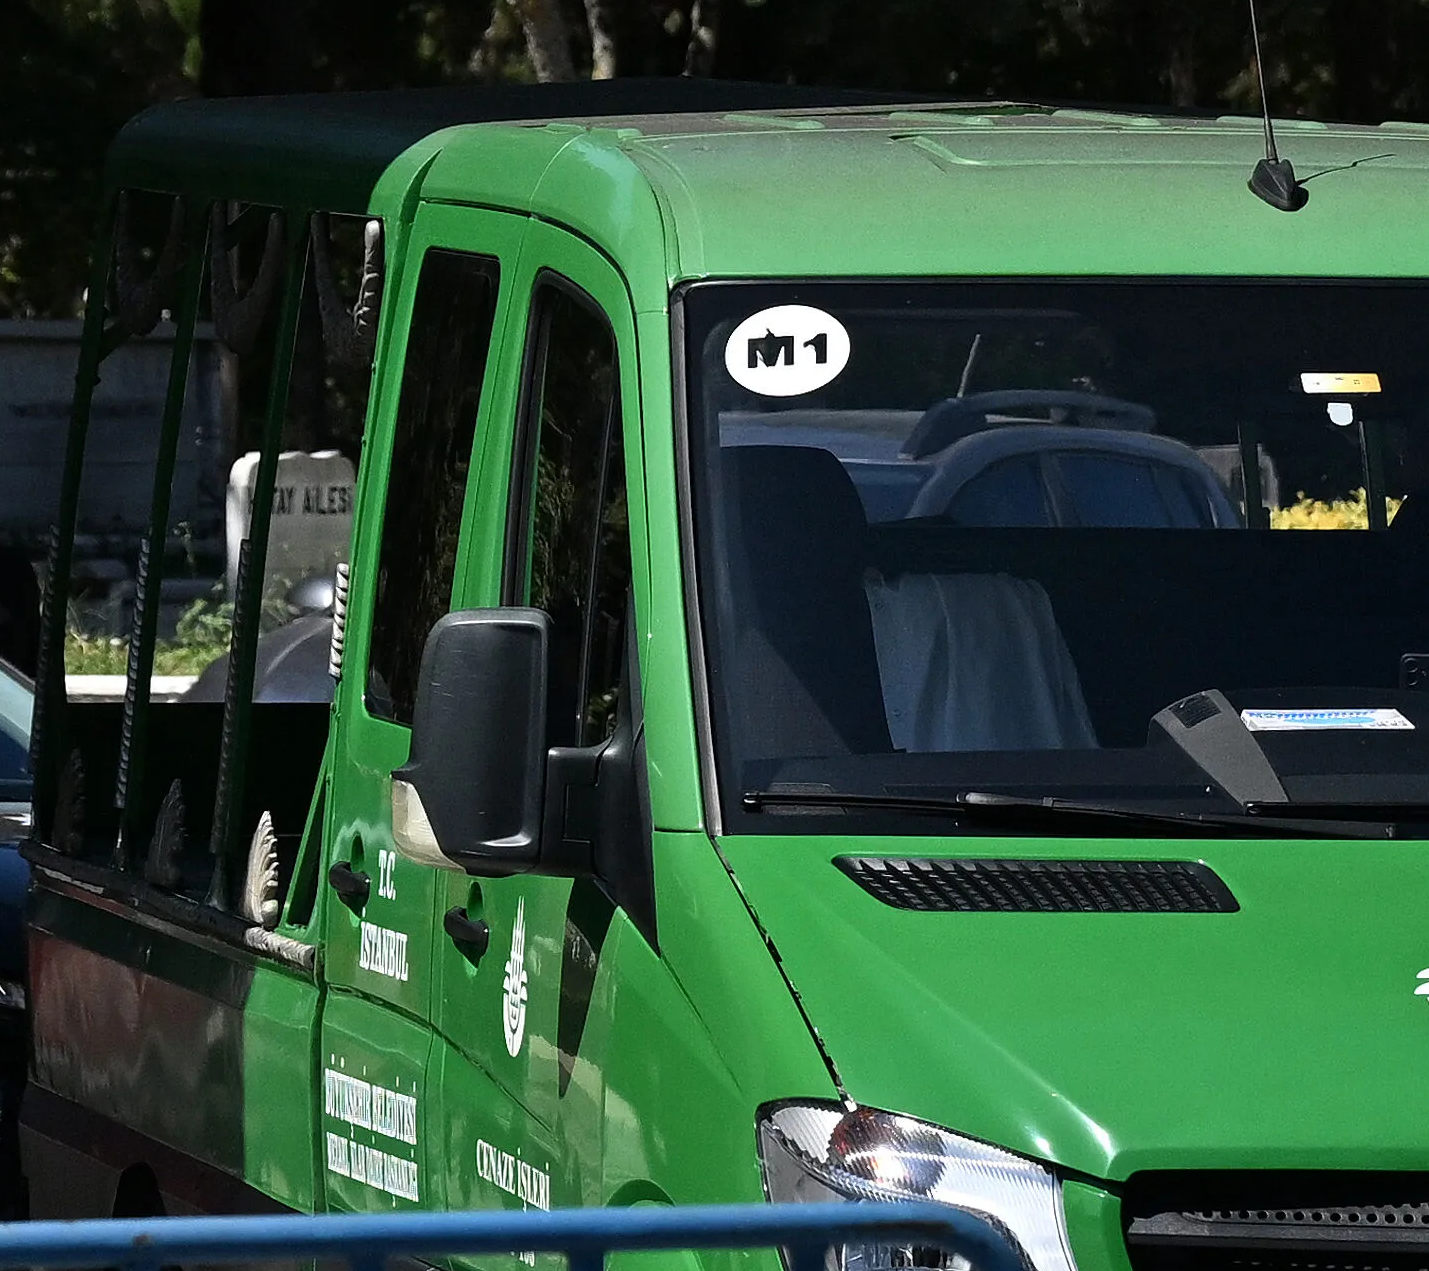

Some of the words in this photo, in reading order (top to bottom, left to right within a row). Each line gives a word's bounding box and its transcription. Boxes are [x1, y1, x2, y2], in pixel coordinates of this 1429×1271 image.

[378, 849, 396, 900] T.C.
[359, 907, 409, 981] İSTANBUL
[476, 1138, 516, 1195] CENAZE
[516, 1147, 550, 1213] İŞLERİ
